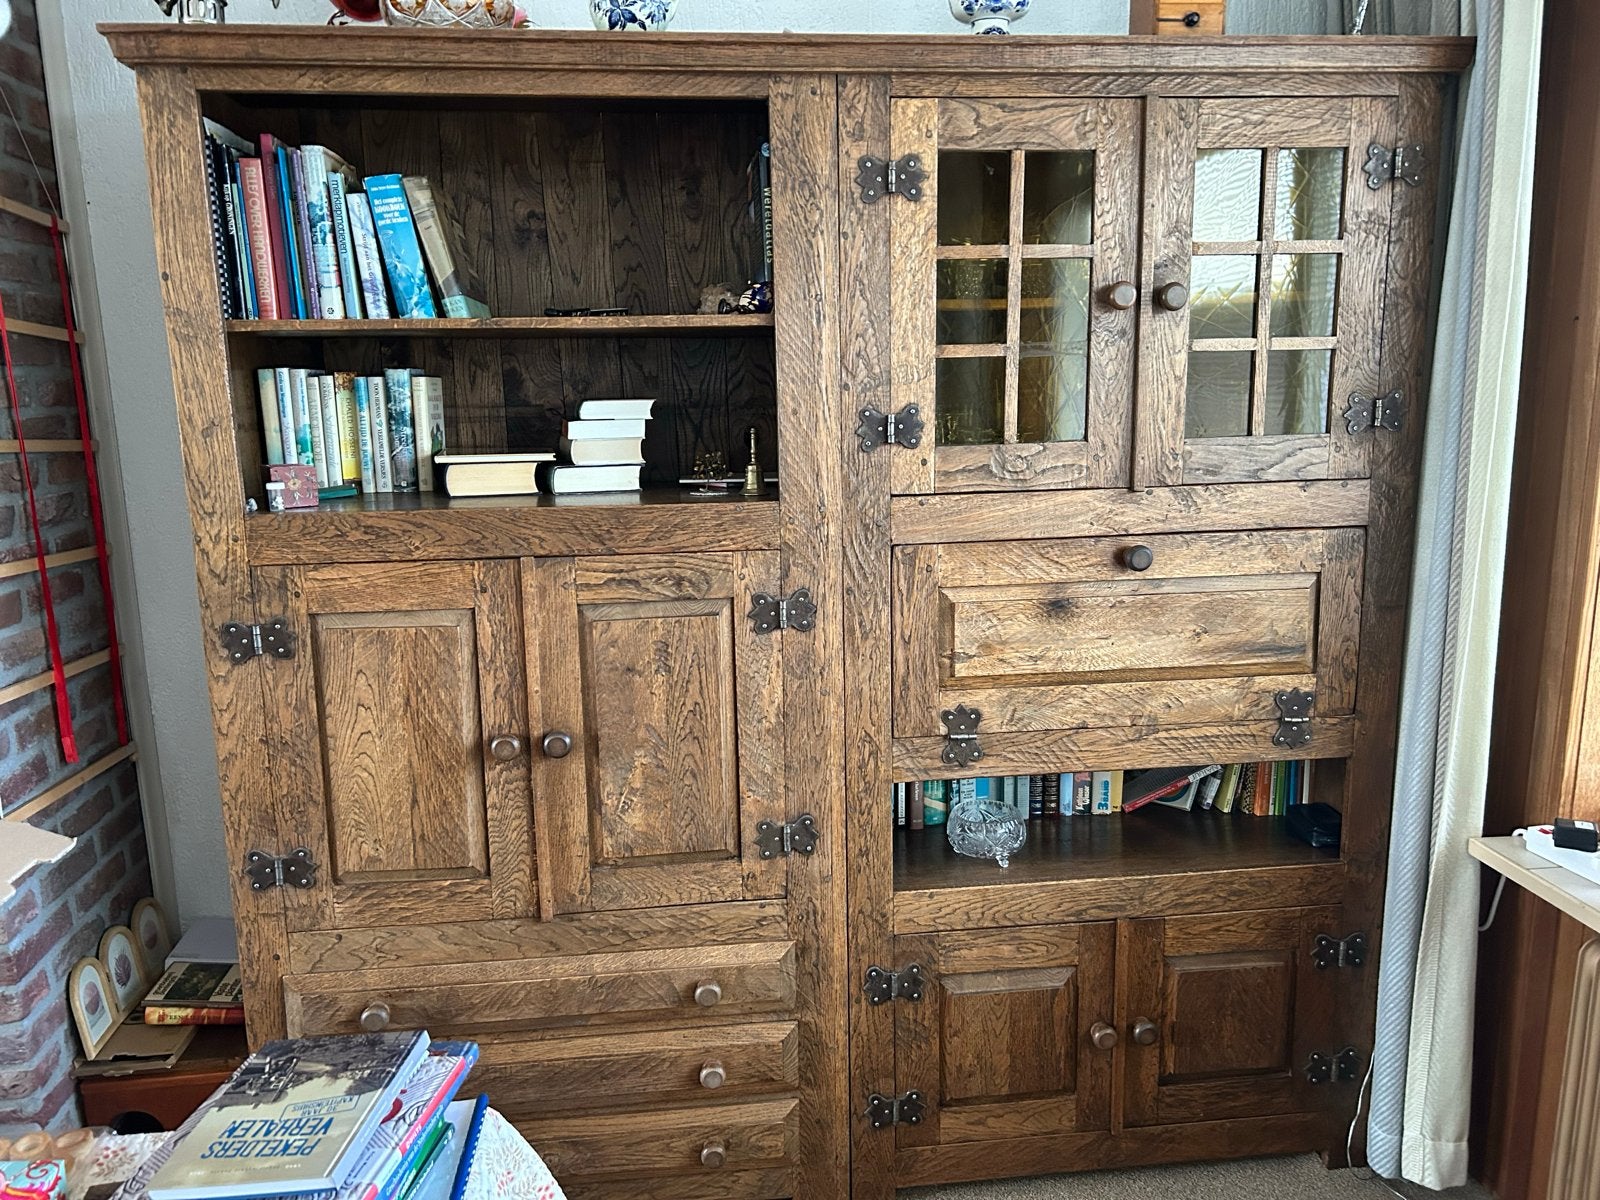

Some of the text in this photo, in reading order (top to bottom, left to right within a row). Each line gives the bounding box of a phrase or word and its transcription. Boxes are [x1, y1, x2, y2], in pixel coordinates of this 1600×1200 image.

[329, 179, 348, 253] merklapmotieven
[244, 166, 270, 303] ALLES OVER HANDWERKEN
[345, 397, 353, 423] KHALED
[347, 426, 356, 458] HOSSEINI
[301, 1107, 323, 1116] JAAR
[218, 1117, 335, 1138] VERHALEN
[201, 1138, 322, 1159] PEKELDERS
